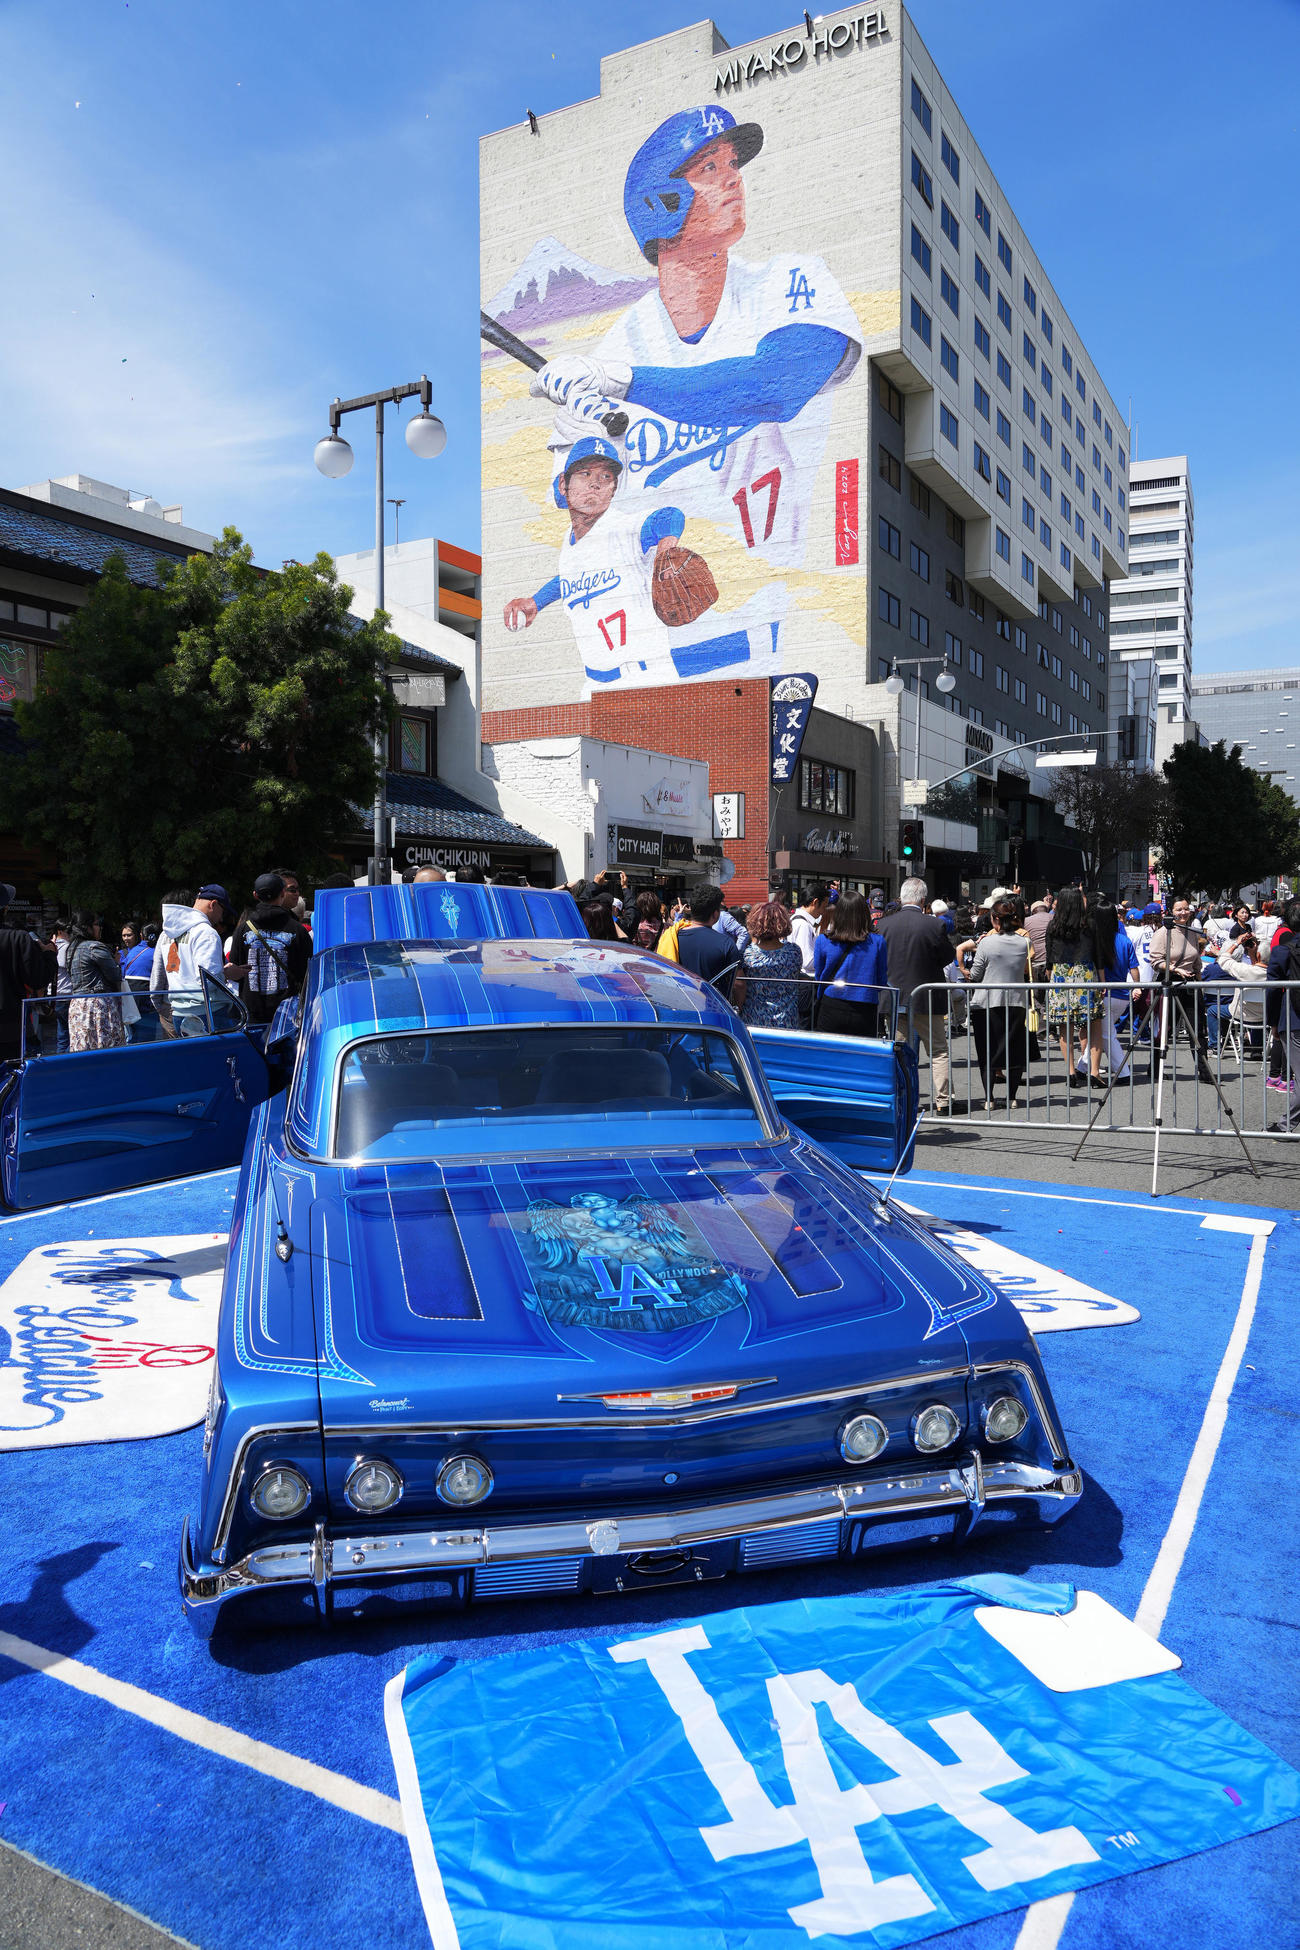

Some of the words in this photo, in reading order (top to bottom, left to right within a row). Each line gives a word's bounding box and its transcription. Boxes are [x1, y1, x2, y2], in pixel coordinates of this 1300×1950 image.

[714, 39, 804, 90] MIYAKO
[812, 10, 888, 56] HOTEL
[698, 106, 725, 136] LA
[785, 267, 816, 313] LA
[594, 439, 606, 455] LA
[841, 465, 849, 494] 2024
[732, 467, 782, 548] 17
[560, 568, 621, 609] Dodgers
[597, 609, 627, 652] 17
[773, 707, 803, 779] 文化堂
[965, 724, 993, 753] MIYAKO
[719, 795, 732, 837] おみやげ
[405, 846, 491, 867] CHINCHIKURIN
[618, 837, 638, 853] CITY
[640, 839, 660, 856] HAIR
[41, 1248, 200, 1304] Major
[580, 1255, 688, 1312] LA
[0, 1304, 138, 1431] League
[606, 1624, 1103, 1940] LA
[1105, 1831, 1141, 1849] TM
